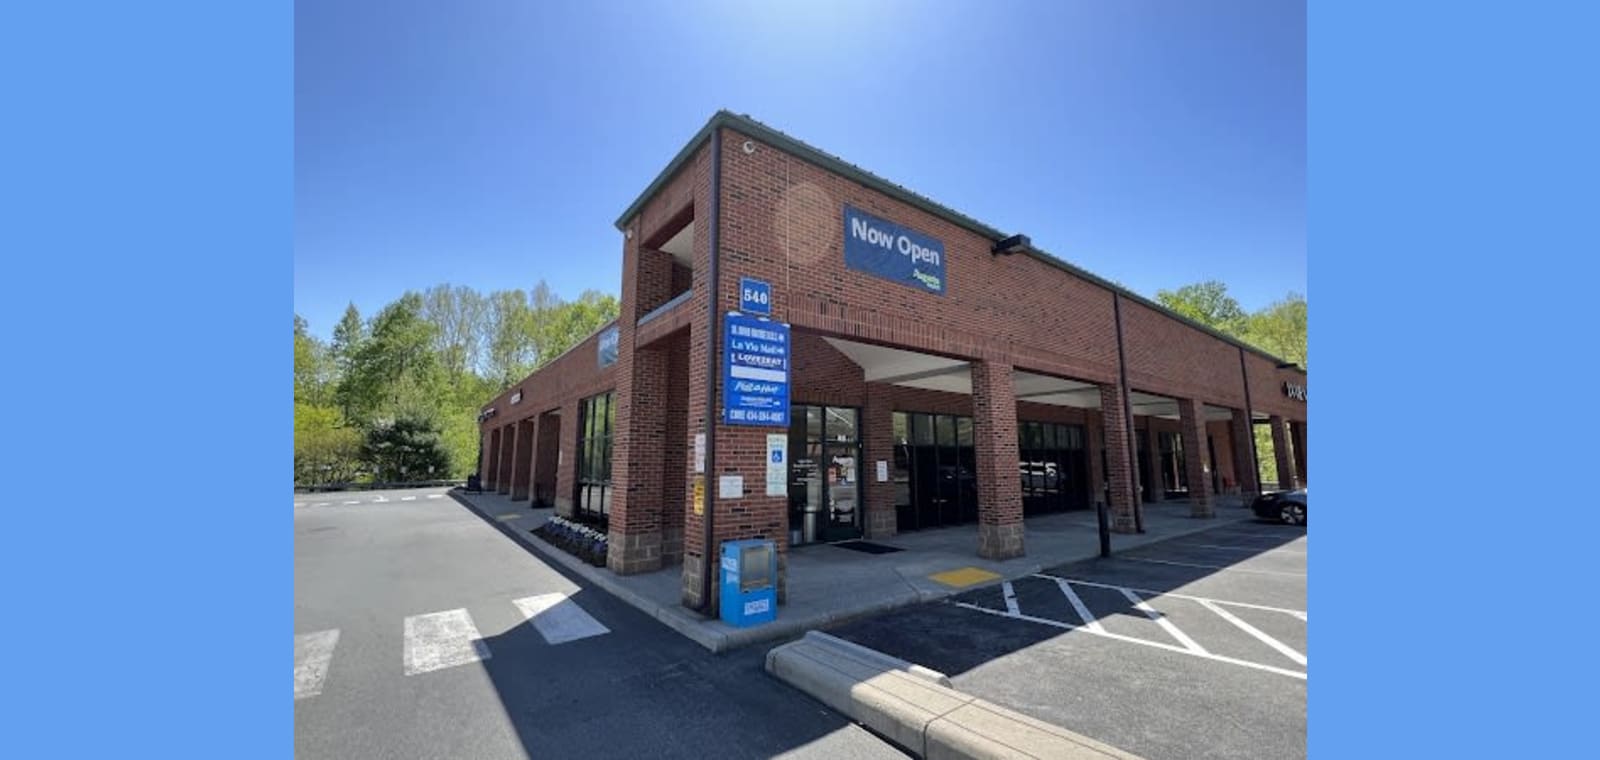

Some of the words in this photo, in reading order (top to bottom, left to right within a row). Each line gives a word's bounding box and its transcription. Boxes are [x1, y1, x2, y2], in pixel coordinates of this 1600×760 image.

[852, 217, 893, 250] Now
[897, 235, 940, 266] Open
[743, 288, 768, 305] 540
